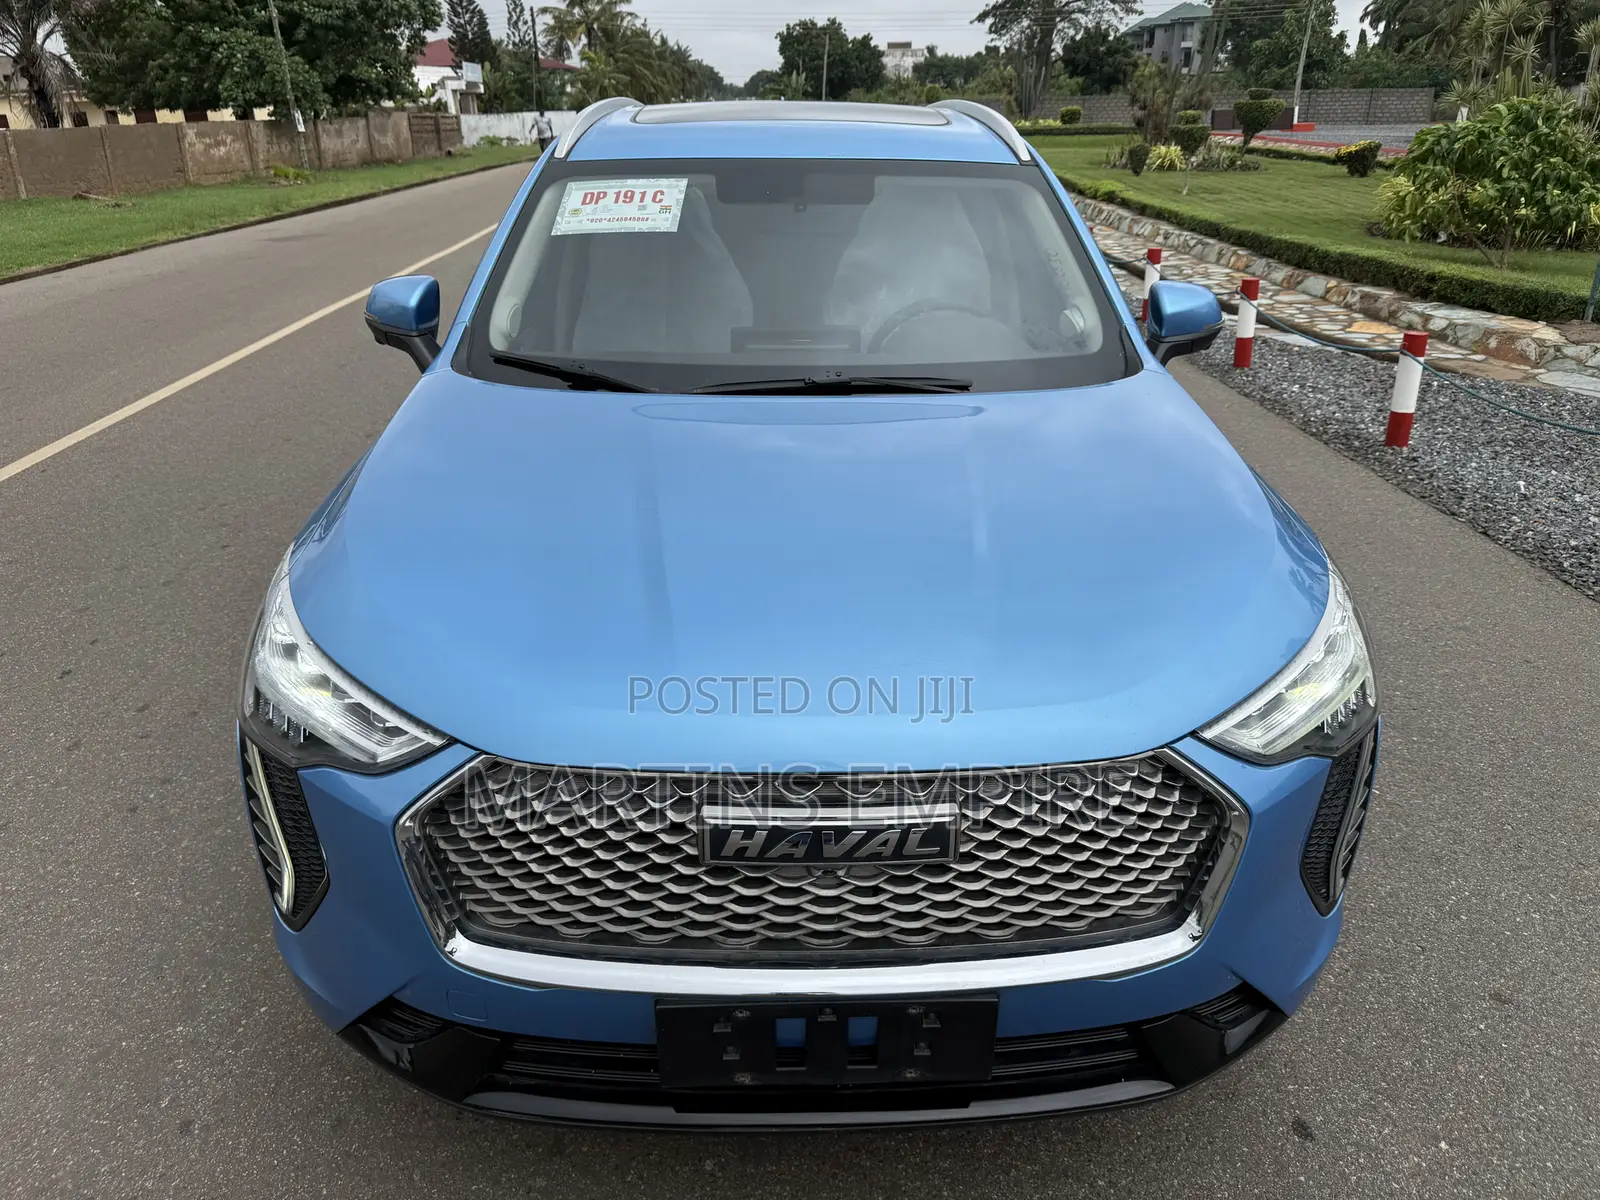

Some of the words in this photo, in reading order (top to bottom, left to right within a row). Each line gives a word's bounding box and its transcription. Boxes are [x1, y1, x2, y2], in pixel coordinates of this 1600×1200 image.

[581, 191, 608, 206] DP
[613, 189, 647, 205] 191
[651, 189, 665, 204] C
[720, 828, 940, 858] HAVAL
